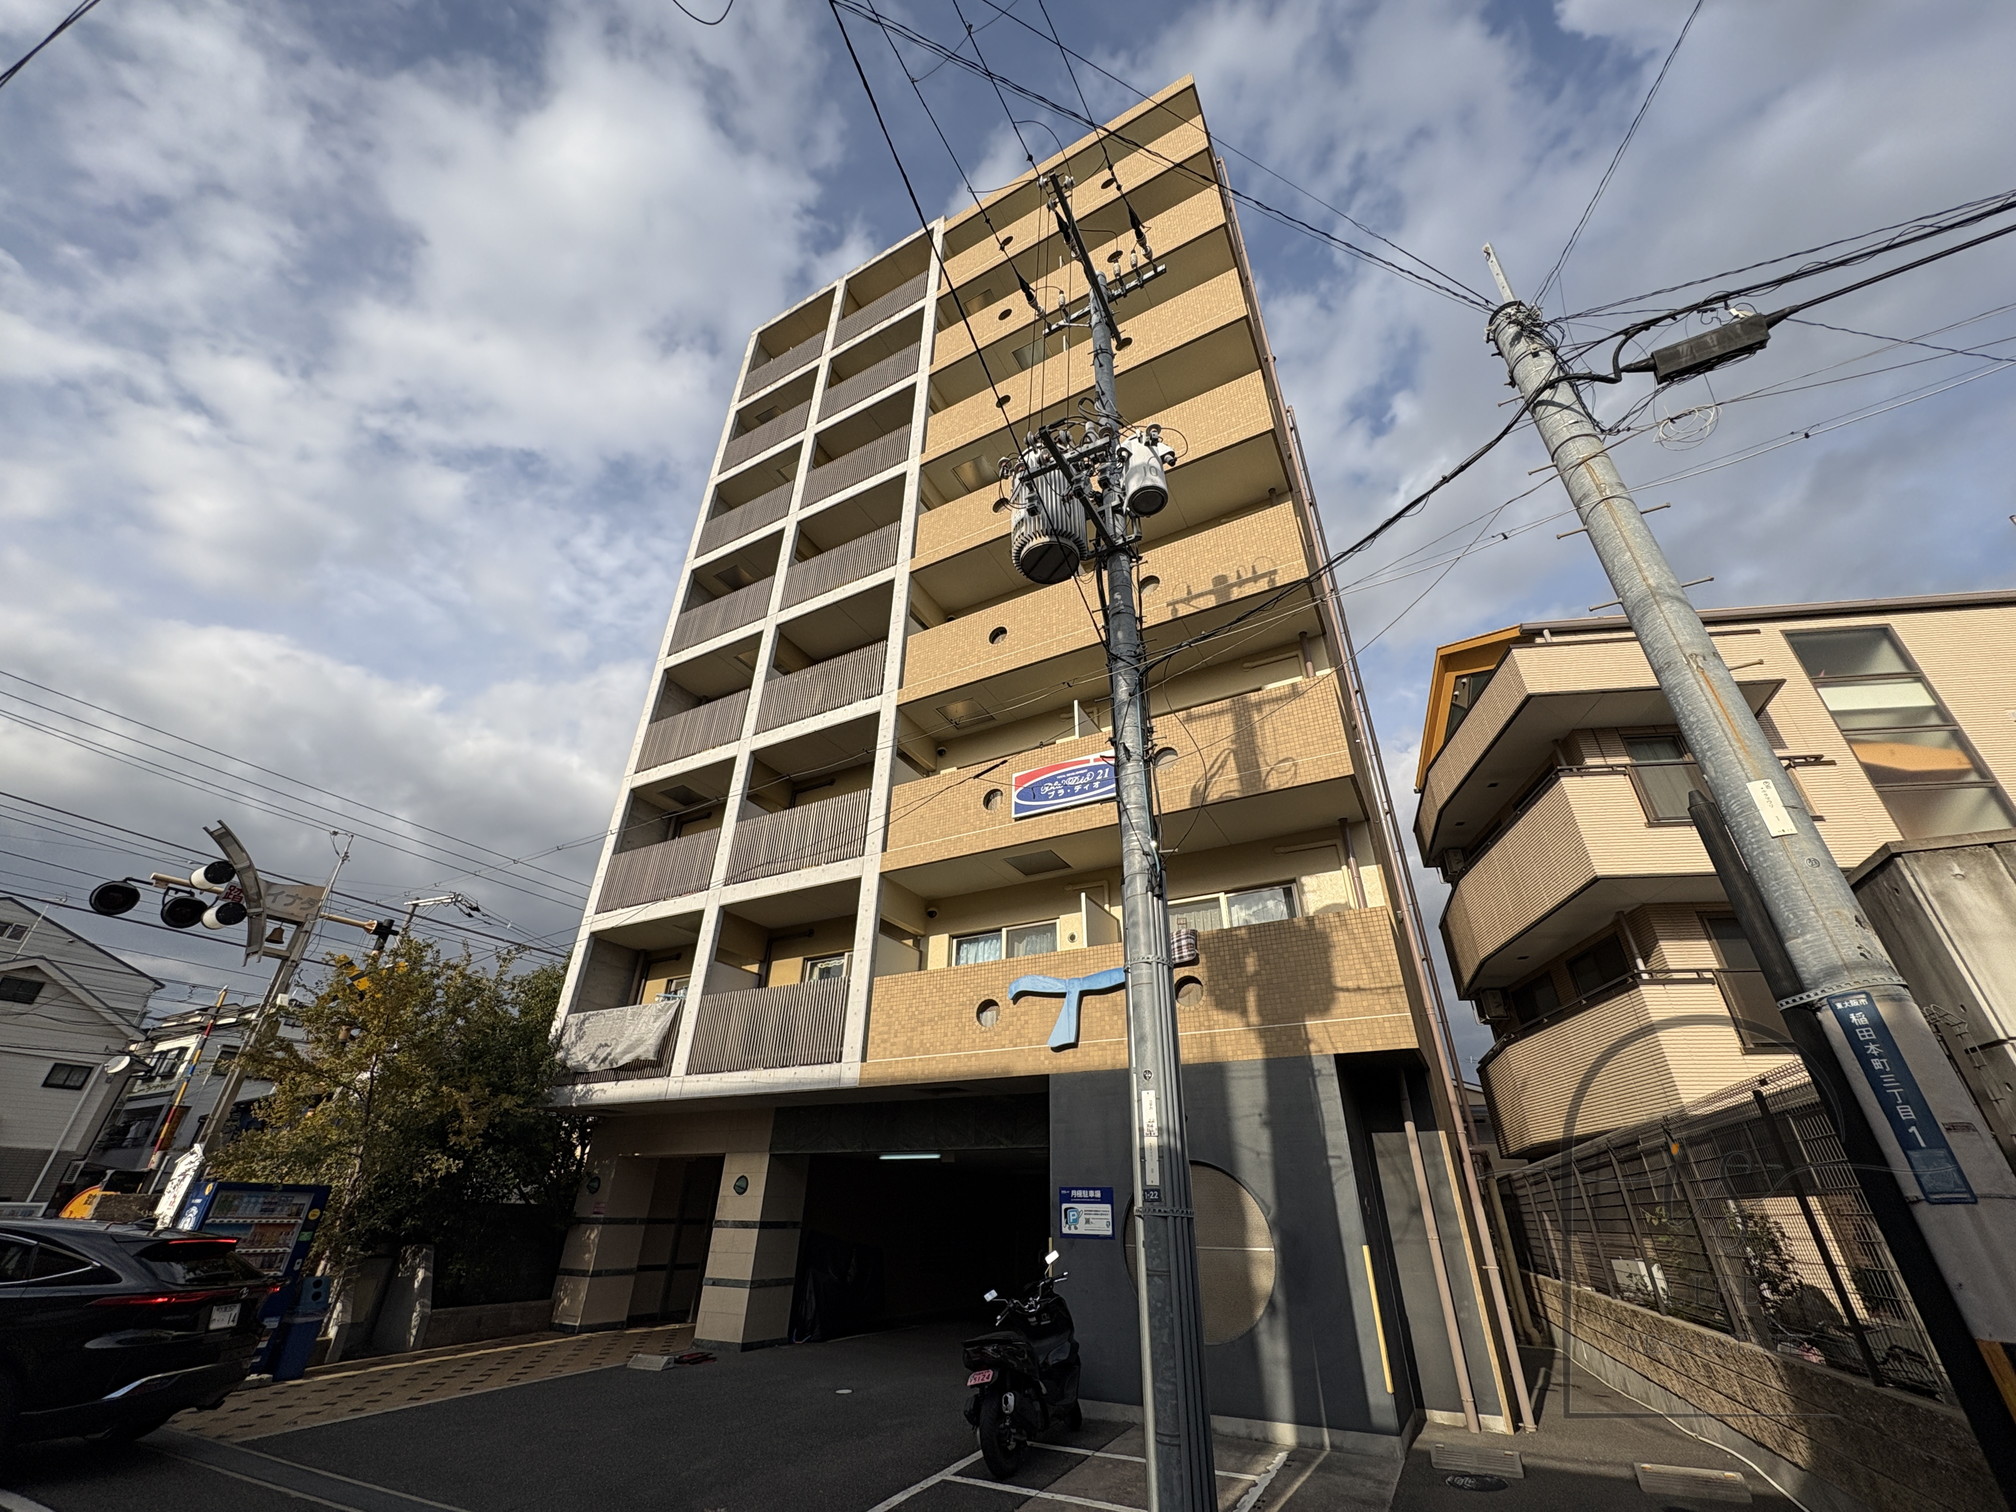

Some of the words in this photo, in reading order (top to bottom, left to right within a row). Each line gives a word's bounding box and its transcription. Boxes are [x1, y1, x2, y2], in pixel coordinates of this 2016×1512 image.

[1096, 767, 1110, 780] 21
[1047, 781, 1101, 799] プラ・ディオ
[1834, 999, 1868, 1010] 東大阪市
